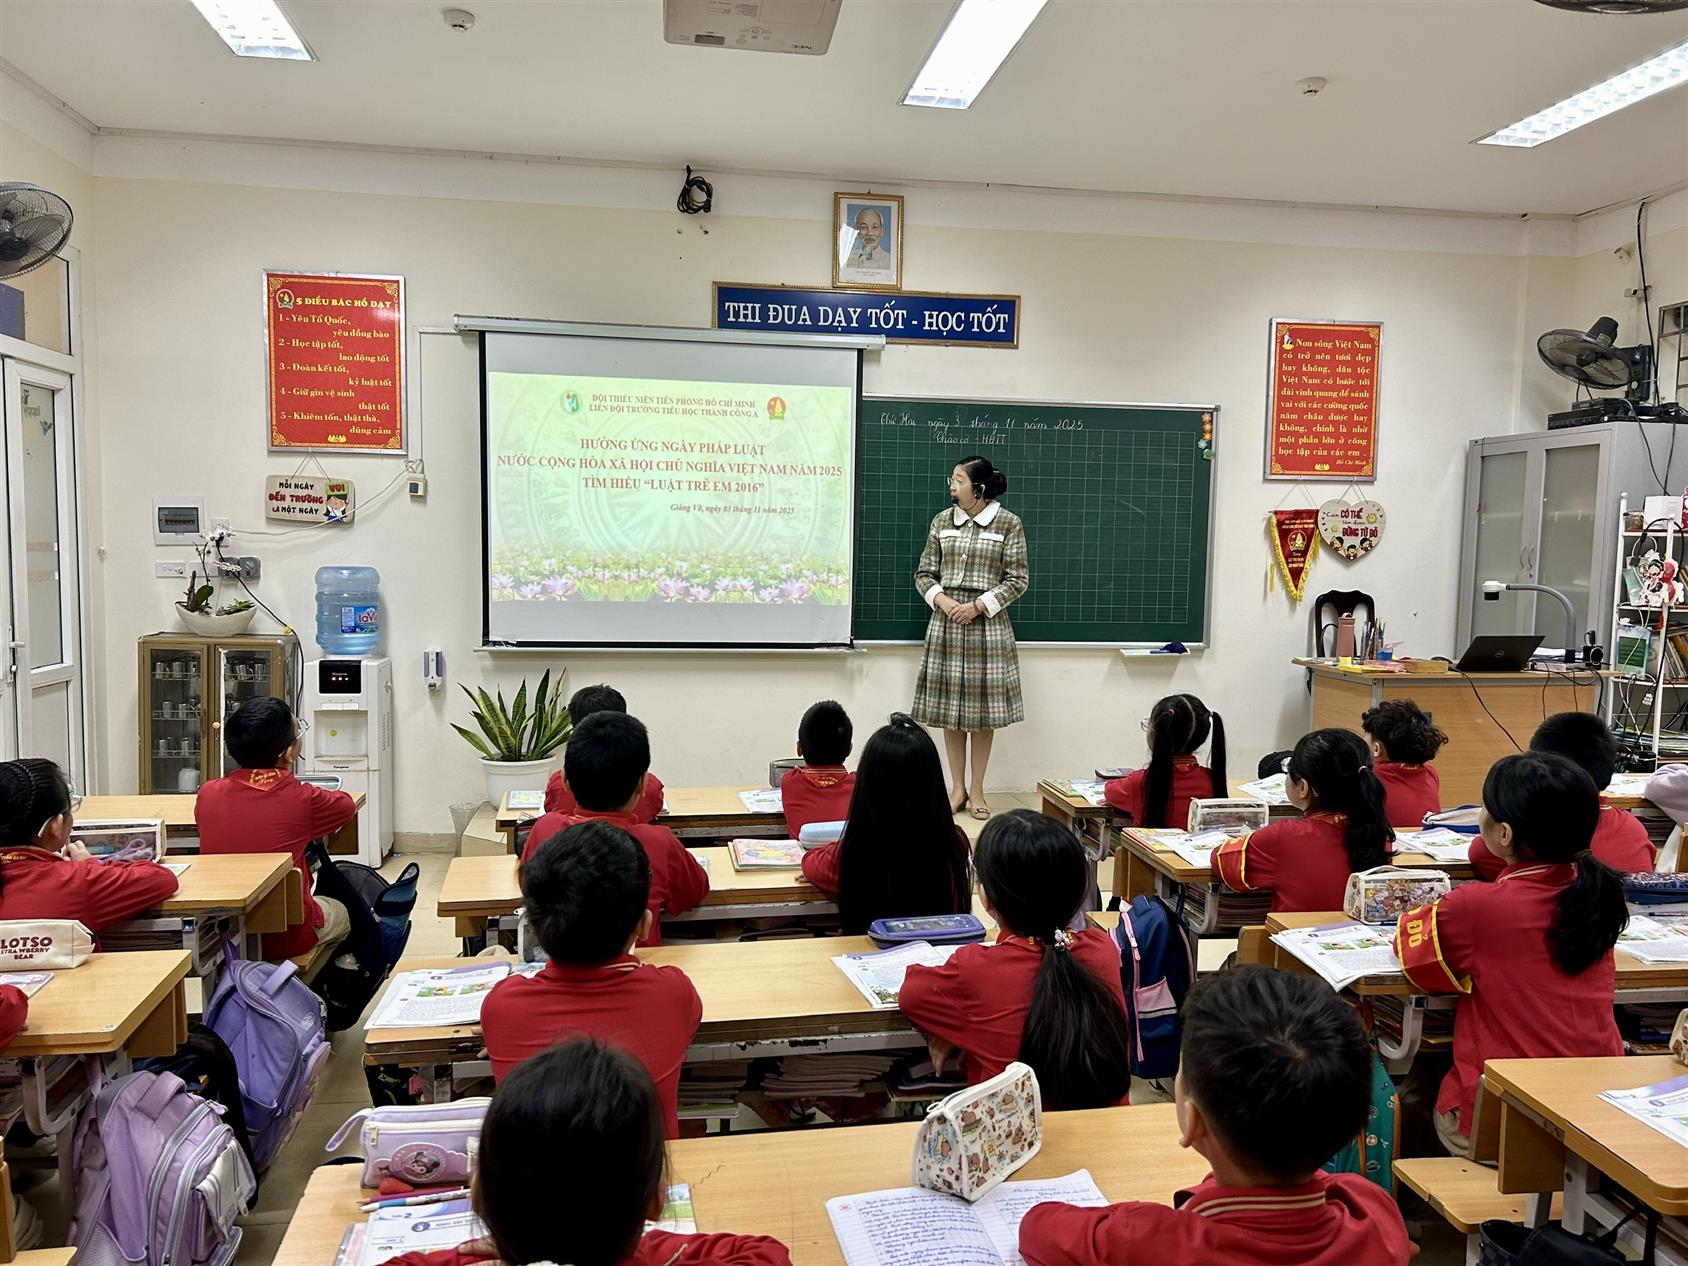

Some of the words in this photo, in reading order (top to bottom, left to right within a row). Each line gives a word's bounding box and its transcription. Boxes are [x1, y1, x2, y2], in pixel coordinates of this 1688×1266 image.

[332, 298, 352, 306] BÁC
[370, 300, 391, 309] DẠY
[725, 302, 761, 322] THI
[768, 306, 812, 326] ĐUA
[818, 306, 863, 332] DẠY
[868, 300, 906, 329] TỐT
[923, 311, 965, 336] HỌC
[970, 304, 1008, 333] TỐT
[1314, 340, 1333, 349] sông
[1335, 340, 1351, 350] Việt
[1353, 341, 1371, 349] Nam
[339, 353, 352, 361] lao
[354, 354, 376, 362] động
[378, 354, 389, 362] tốt
[1282, 364, 1296, 373] hay
[1302, 364, 1330, 374] không,
[1336, 365, 1352, 373] dân
[1357, 367, 1370, 375] tộc
[362, 378, 378, 386] luật
[380, 378, 392, 386] tốt
[1282, 375, 1298, 384] Việt
[359, 402, 376, 410] thật
[378, 402, 389, 410] tốt
[580, 436, 627, 450] HƯỞNG
[630, 438, 658, 452] ỨNG
[661, 440, 696, 453] NGÀY
[699, 442, 732, 454] PHÁP
[734, 444, 766, 458] LUẬT
[1279, 447, 1293, 456] học
[1297, 448, 1310, 456] tập
[497, 453, 536, 466] NƯỚC
[539, 456, 576, 470] CỘNG
[579, 456, 606, 469] HÒA
[609, 457, 627, 470] XÃ
[630, 459, 653, 472] HỘI
[656, 458, 683, 472] CHỦ
[686, 460, 725, 473] NGHĨA
[728, 463, 756, 476] VIỆT
[759, 464, 787, 474] NAM
[789, 464, 817, 476] NĂM
[819, 466, 842, 476] 2025
[294, 482, 314, 490] NGÀY
[329, 484, 345, 492] VUI
[582, 475, 606, 489] TÌM
[610, 476, 641, 489] HIỂU
[687, 478, 710, 491] TRẺ
[713, 481, 732, 492] EM
[281, 505, 296, 514] MỘT
[1406, 918, 1429, 948] ĐỎ
[1, 937, 52, 949] LOTSO
